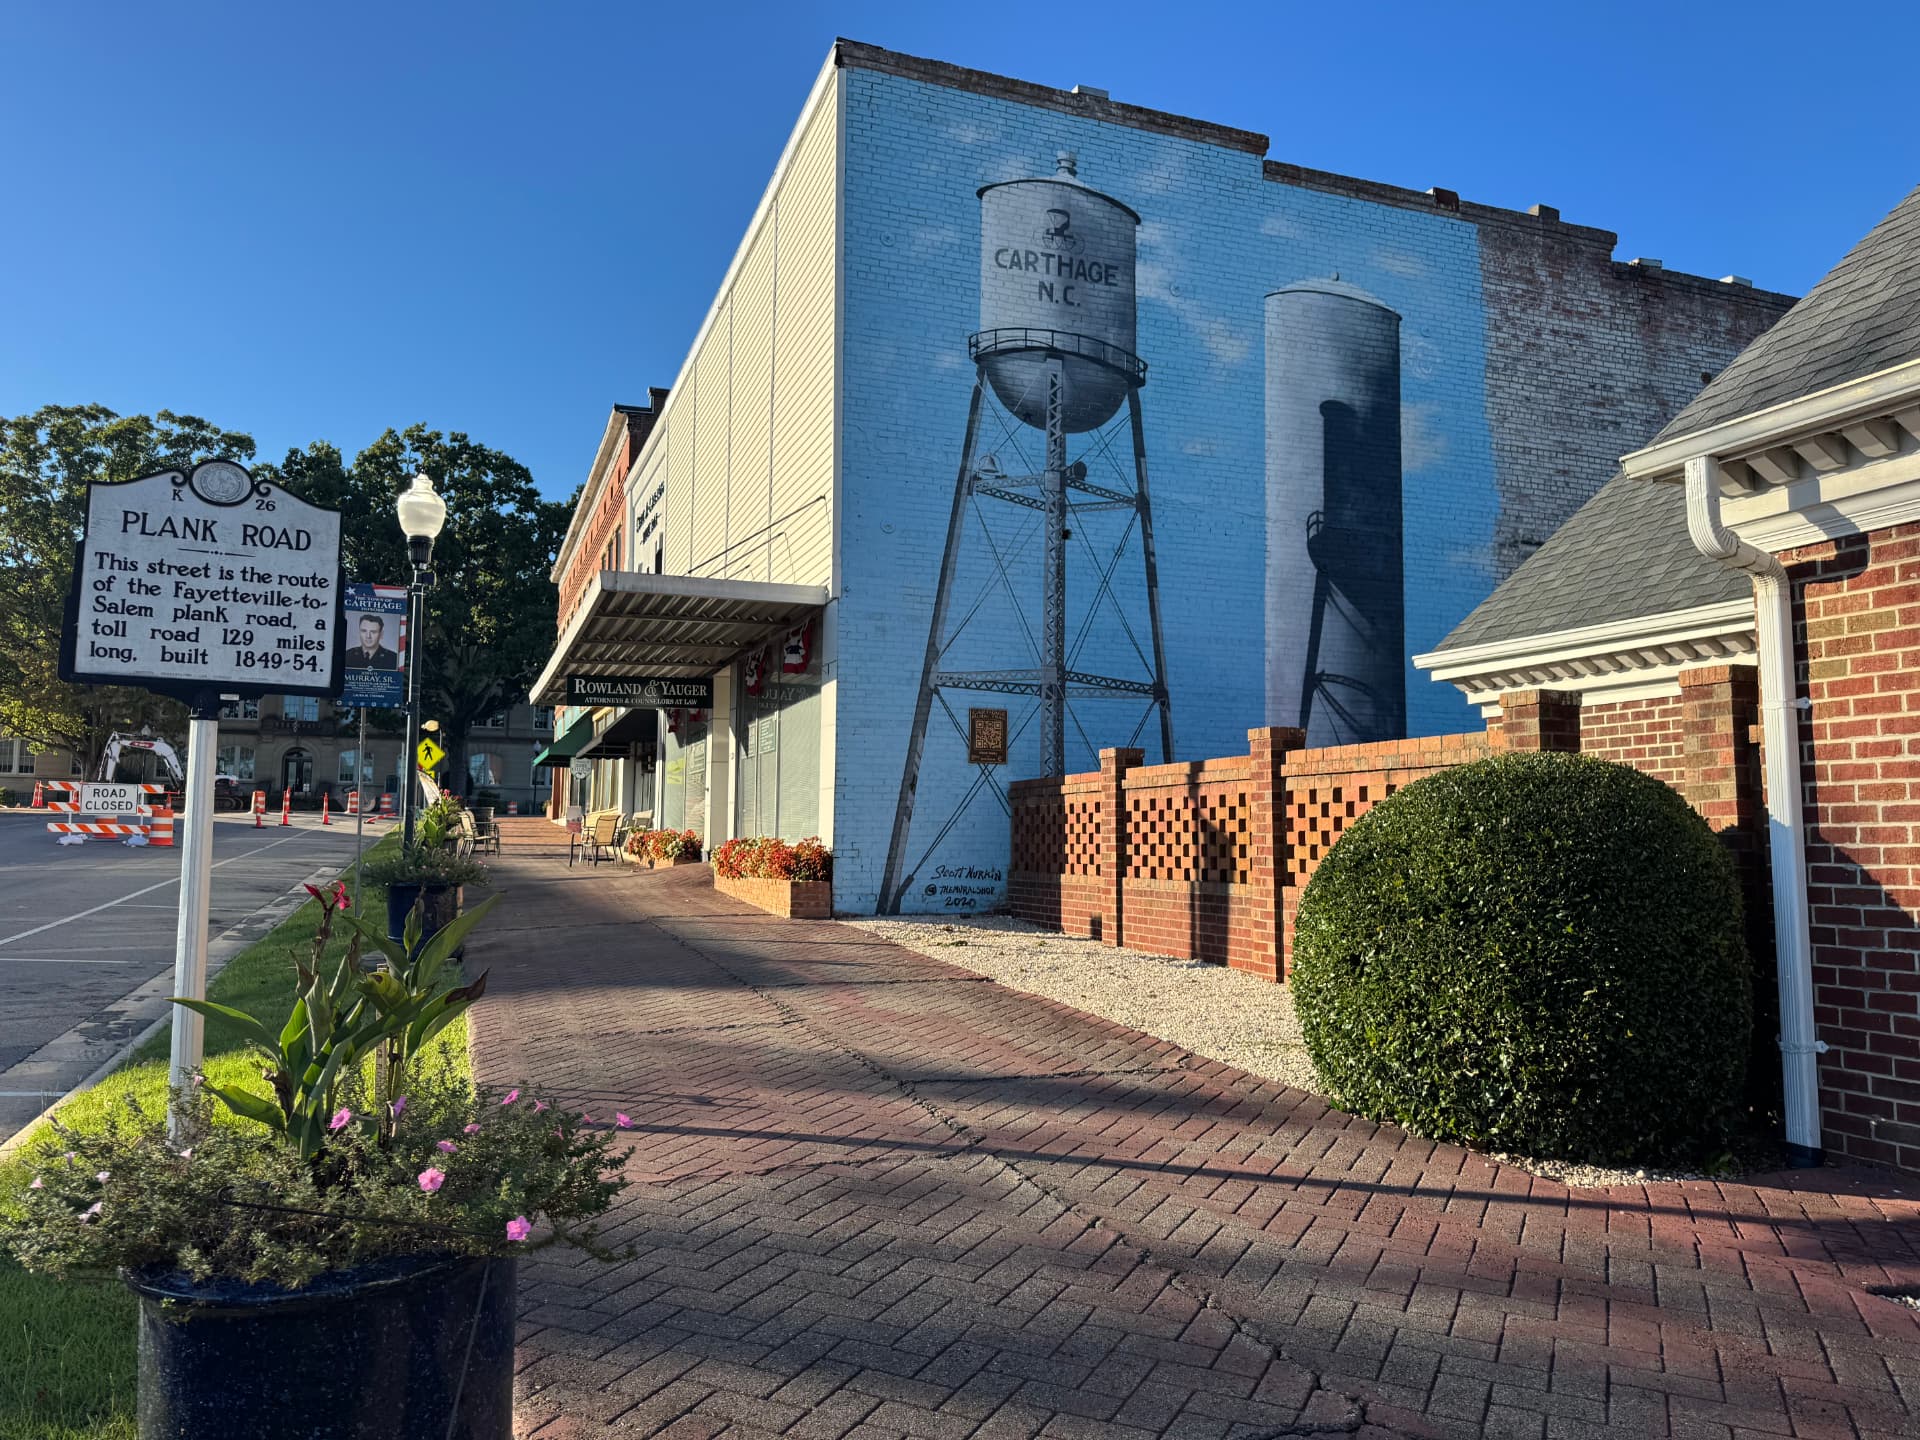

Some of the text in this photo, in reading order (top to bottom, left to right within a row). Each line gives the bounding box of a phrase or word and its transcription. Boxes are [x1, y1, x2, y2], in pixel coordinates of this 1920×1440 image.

[995, 248, 1120, 286] CARTHAGE
[172, 489, 276, 511] K 26
[121, 510, 312, 551] PLANK ROAD
[94, 552, 330, 589] This street is the route
[93, 576, 328, 610] of the Fayetteville-to-
[344, 599, 402, 609] CARTHAGE
[92, 596, 326, 631] Salem plank road, a
[91, 618, 326, 652] toll road 129 miles
[160, 644, 209, 666] built
[235, 650, 324, 673] 1849-54.
[644, 680, 660, 697] &
[85, 800, 133, 811] CLOSED
[93, 788, 127, 798] ROAD
[945, 897, 976, 907] 2020
